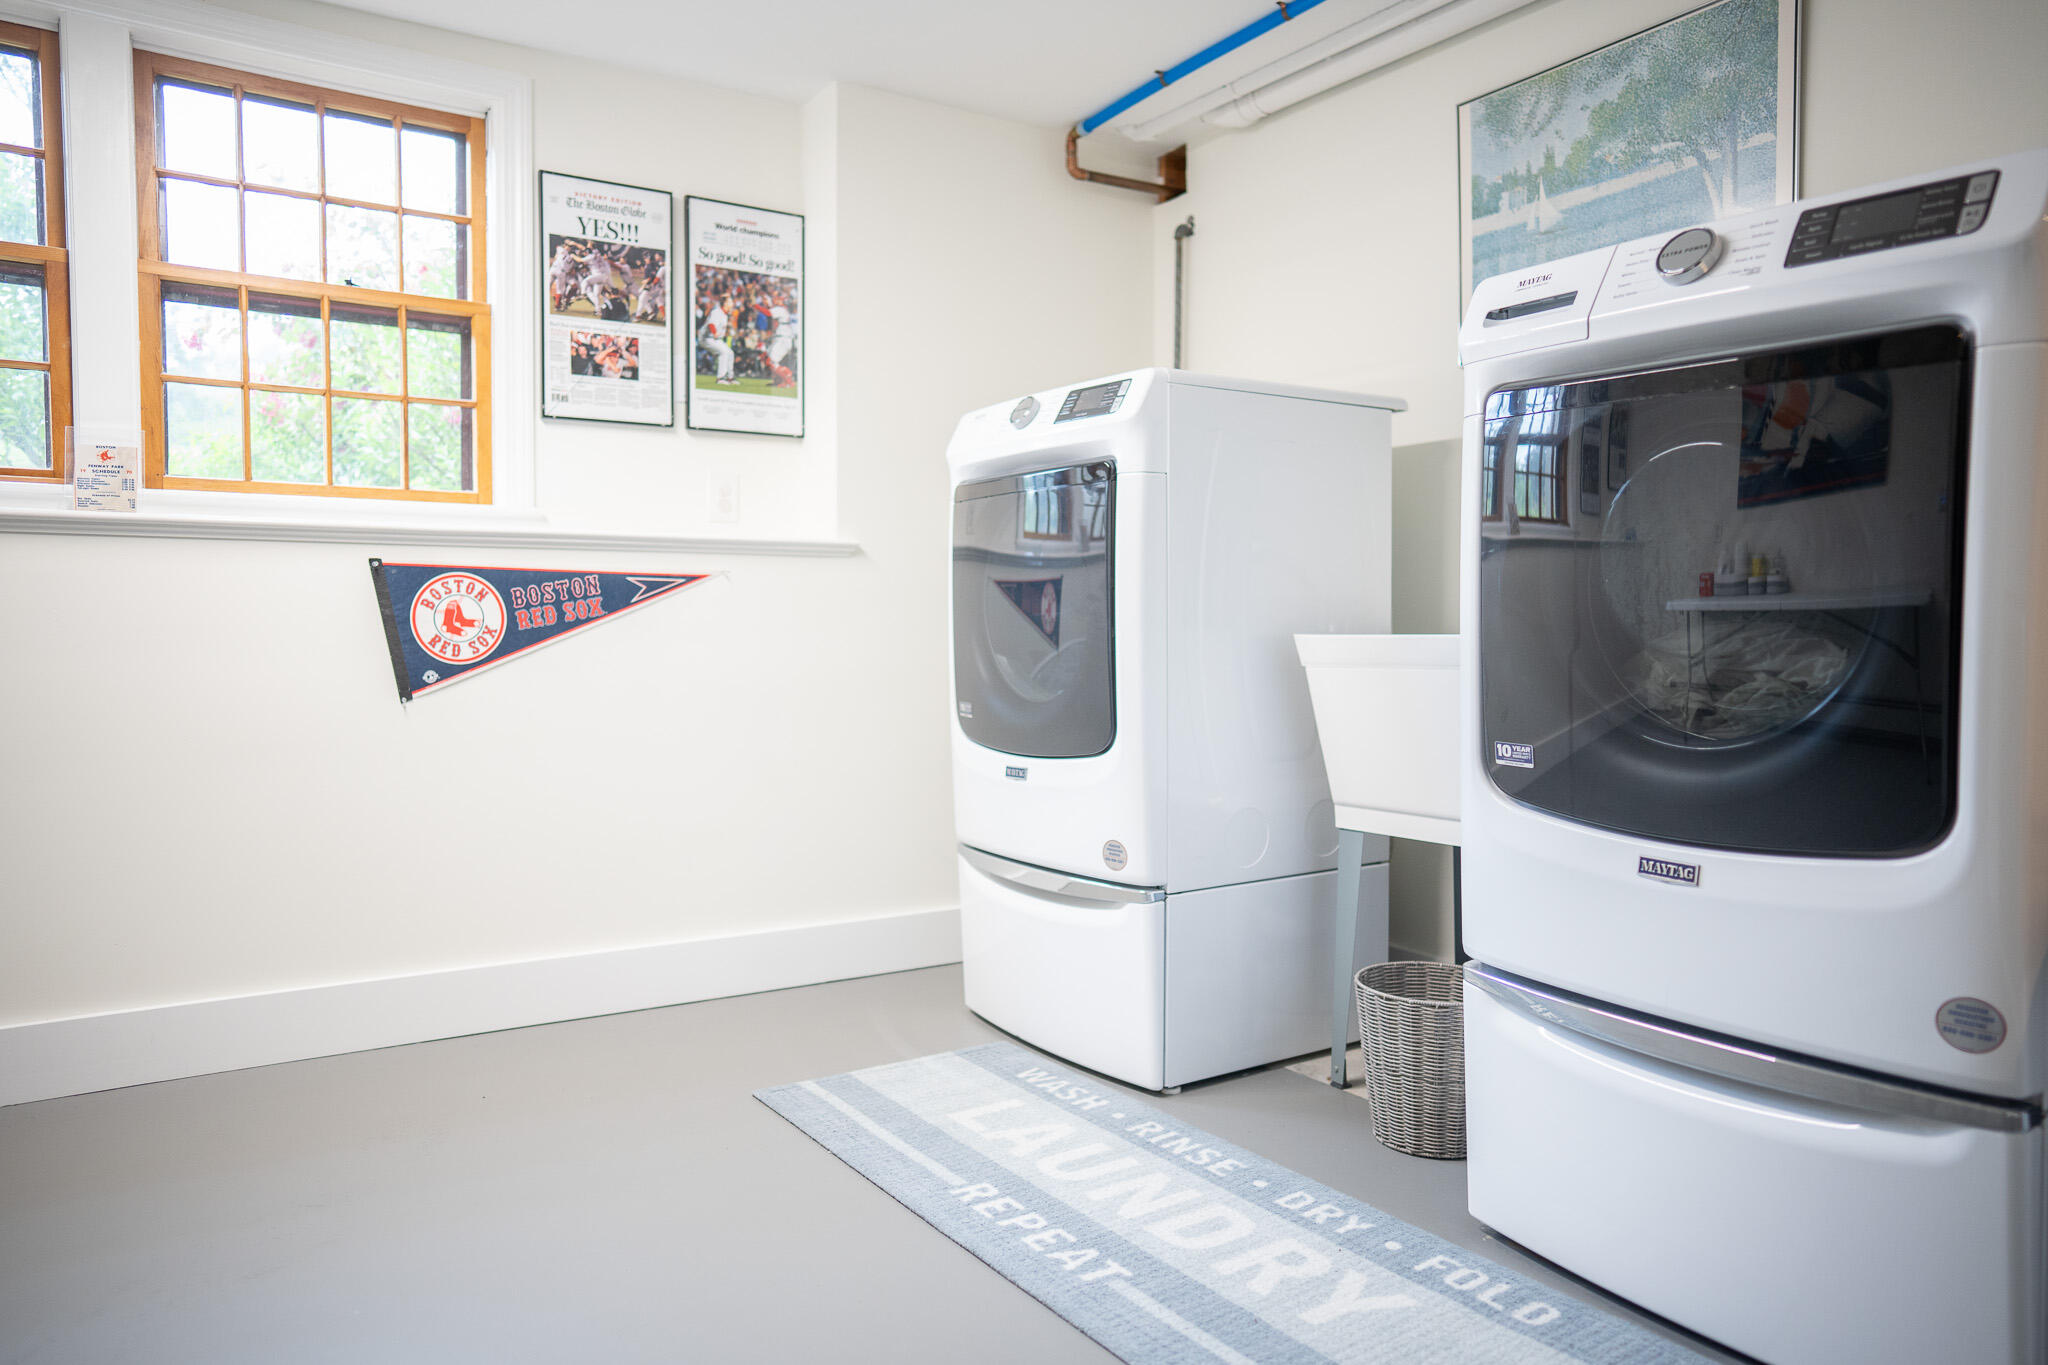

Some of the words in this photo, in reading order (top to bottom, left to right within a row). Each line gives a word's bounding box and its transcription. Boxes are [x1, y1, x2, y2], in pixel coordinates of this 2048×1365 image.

[566, 197, 584, 209] The
[587, 200, 620, 215] Boston
[621, 205, 647, 219] Globe
[577, 216, 639, 243] YES!!!
[714, 223, 738, 233] World
[698, 246, 714, 260] So
[716, 250, 746, 265] good!
[749, 254, 764, 268] So
[765, 260, 795, 273] good!
[1518, 273, 1553, 288] MAYTAG
[420, 579, 490, 611] BOSTON
[510, 574, 601, 609] BOSTON
[515, 604, 558, 630] RED
[562, 597, 605, 623] SOX
[427, 634, 462, 658] RED
[468, 625, 498, 655] SOX
[1496, 743, 1512, 758] 10
[1511, 745, 1531, 753] YEAR
[1640, 859, 1695, 880] MAYTAG
[1015, 1066, 1109, 1119] WASH
[1125, 1121, 1248, 1178] RINSE
[1275, 1190, 1376, 1236] DRY
[1414, 1254, 1563, 1327] FOLD
[948, 1098, 1423, 1326] LAUNDRY
[951, 1182, 1132, 1286] REPEAT
